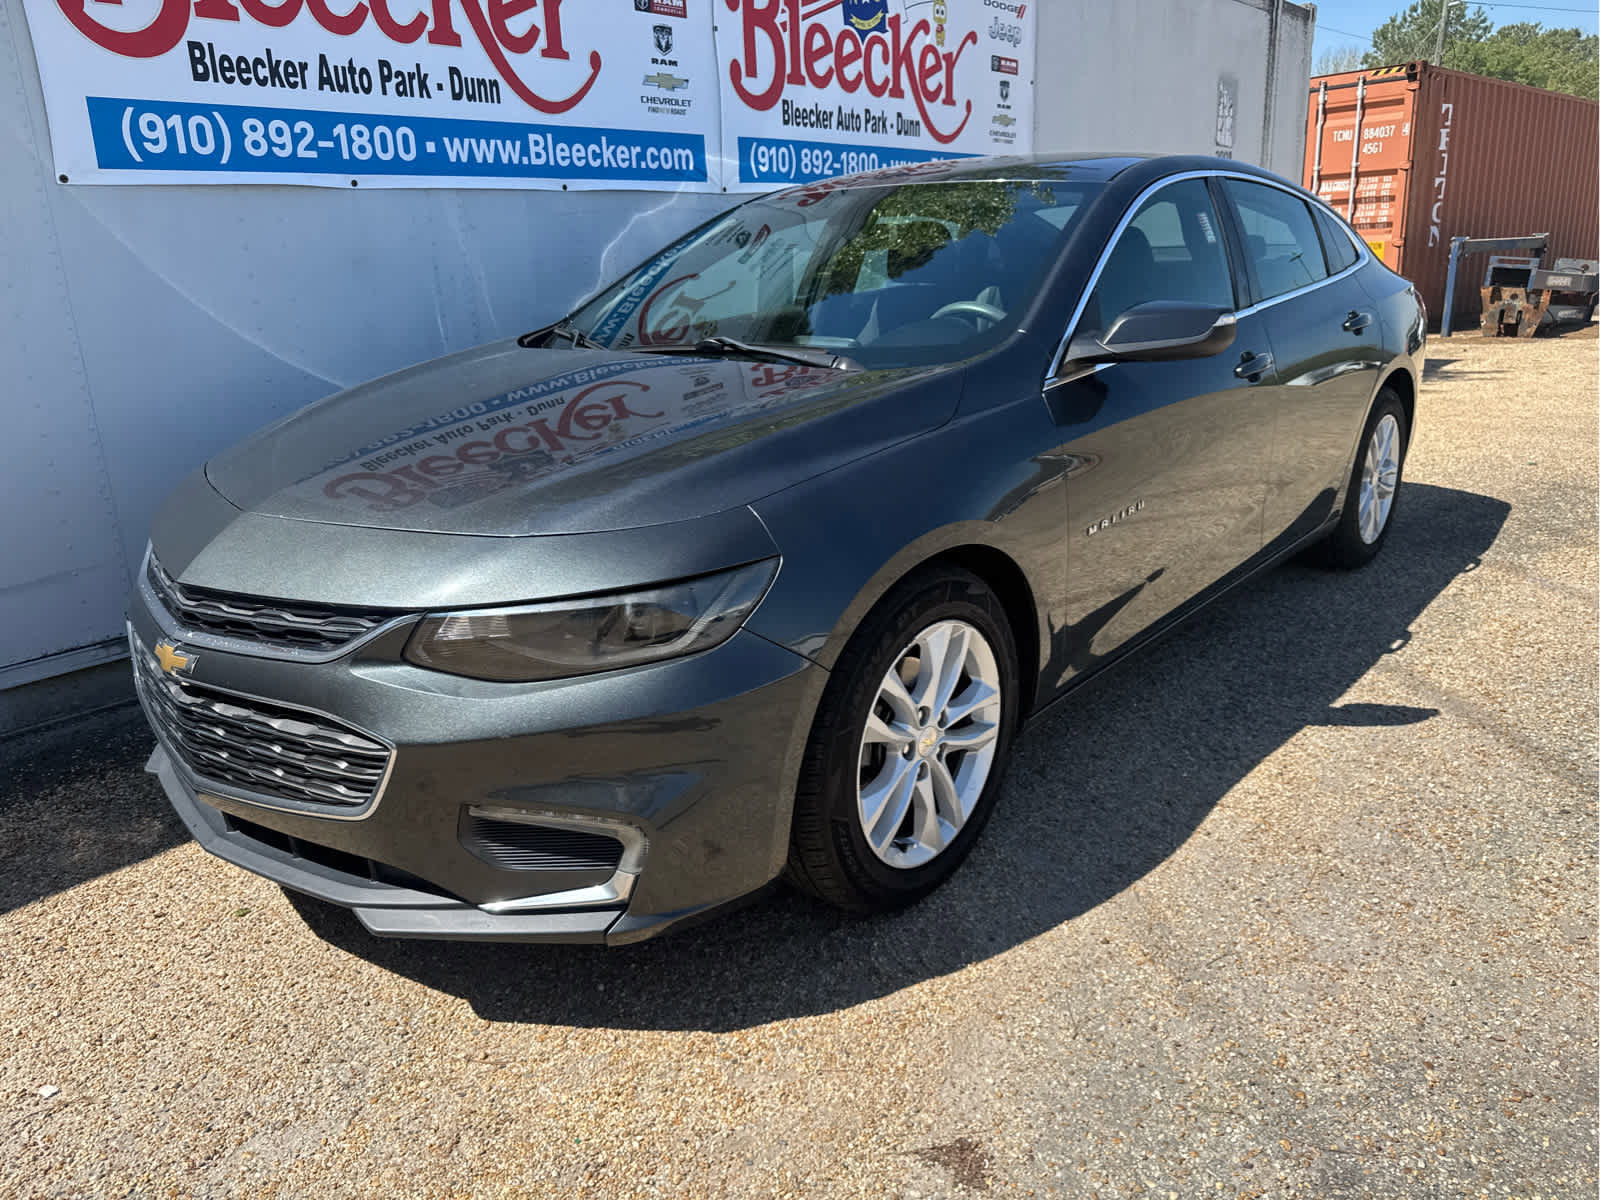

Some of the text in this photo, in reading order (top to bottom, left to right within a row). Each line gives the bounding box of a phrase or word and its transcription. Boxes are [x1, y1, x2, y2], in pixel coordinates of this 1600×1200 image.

[988, 16, 1022, 48] Jeep
[187, 40, 502, 104] Bleecker Auto Park Dunn
[650, 57, 679, 67] RAM
[729, 0, 978, 144] Bleecker
[640, 95, 692, 107] CHEVROLET
[781, 98, 921, 137] Bleecker Auto Park Dunn
[122, 106, 695, 171] (910) 892-1800 www.Bleecker.com
[1362, 141, 1384, 155] 45G1
[1363, 125, 1396, 140] 884037
[750, 141, 878, 179] (910) 892-1800
